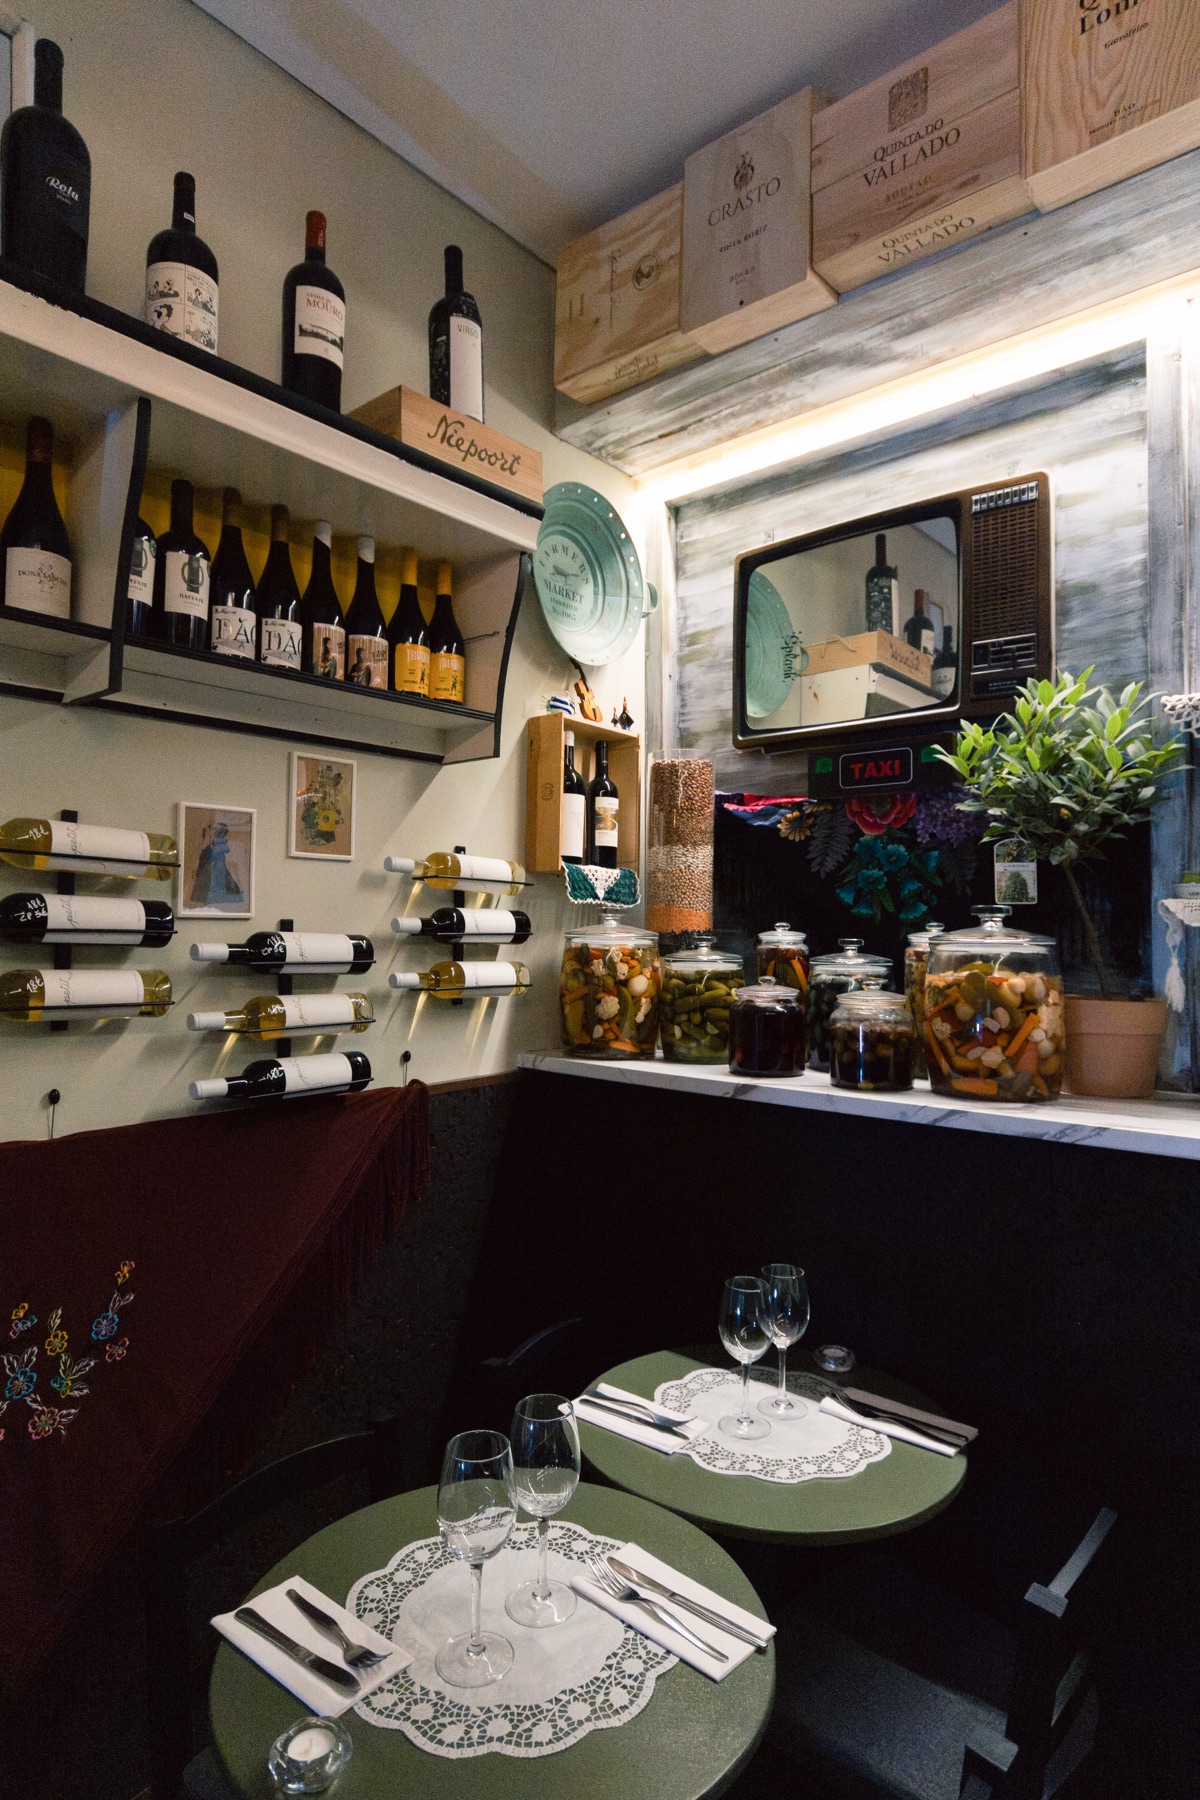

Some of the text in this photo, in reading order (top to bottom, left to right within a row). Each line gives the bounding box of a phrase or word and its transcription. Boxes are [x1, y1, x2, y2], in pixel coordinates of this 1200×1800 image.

[863, 127, 961, 187] VALLADO
[708, 177, 781, 227] CRASTO
[877, 217, 975, 262] VALLADO
[306, 298, 343, 321] MOURO
[427, 414, 521, 476] Niepoort
[543, 578, 584, 604] MARKET
[849, 759, 901, 780] TAXI
